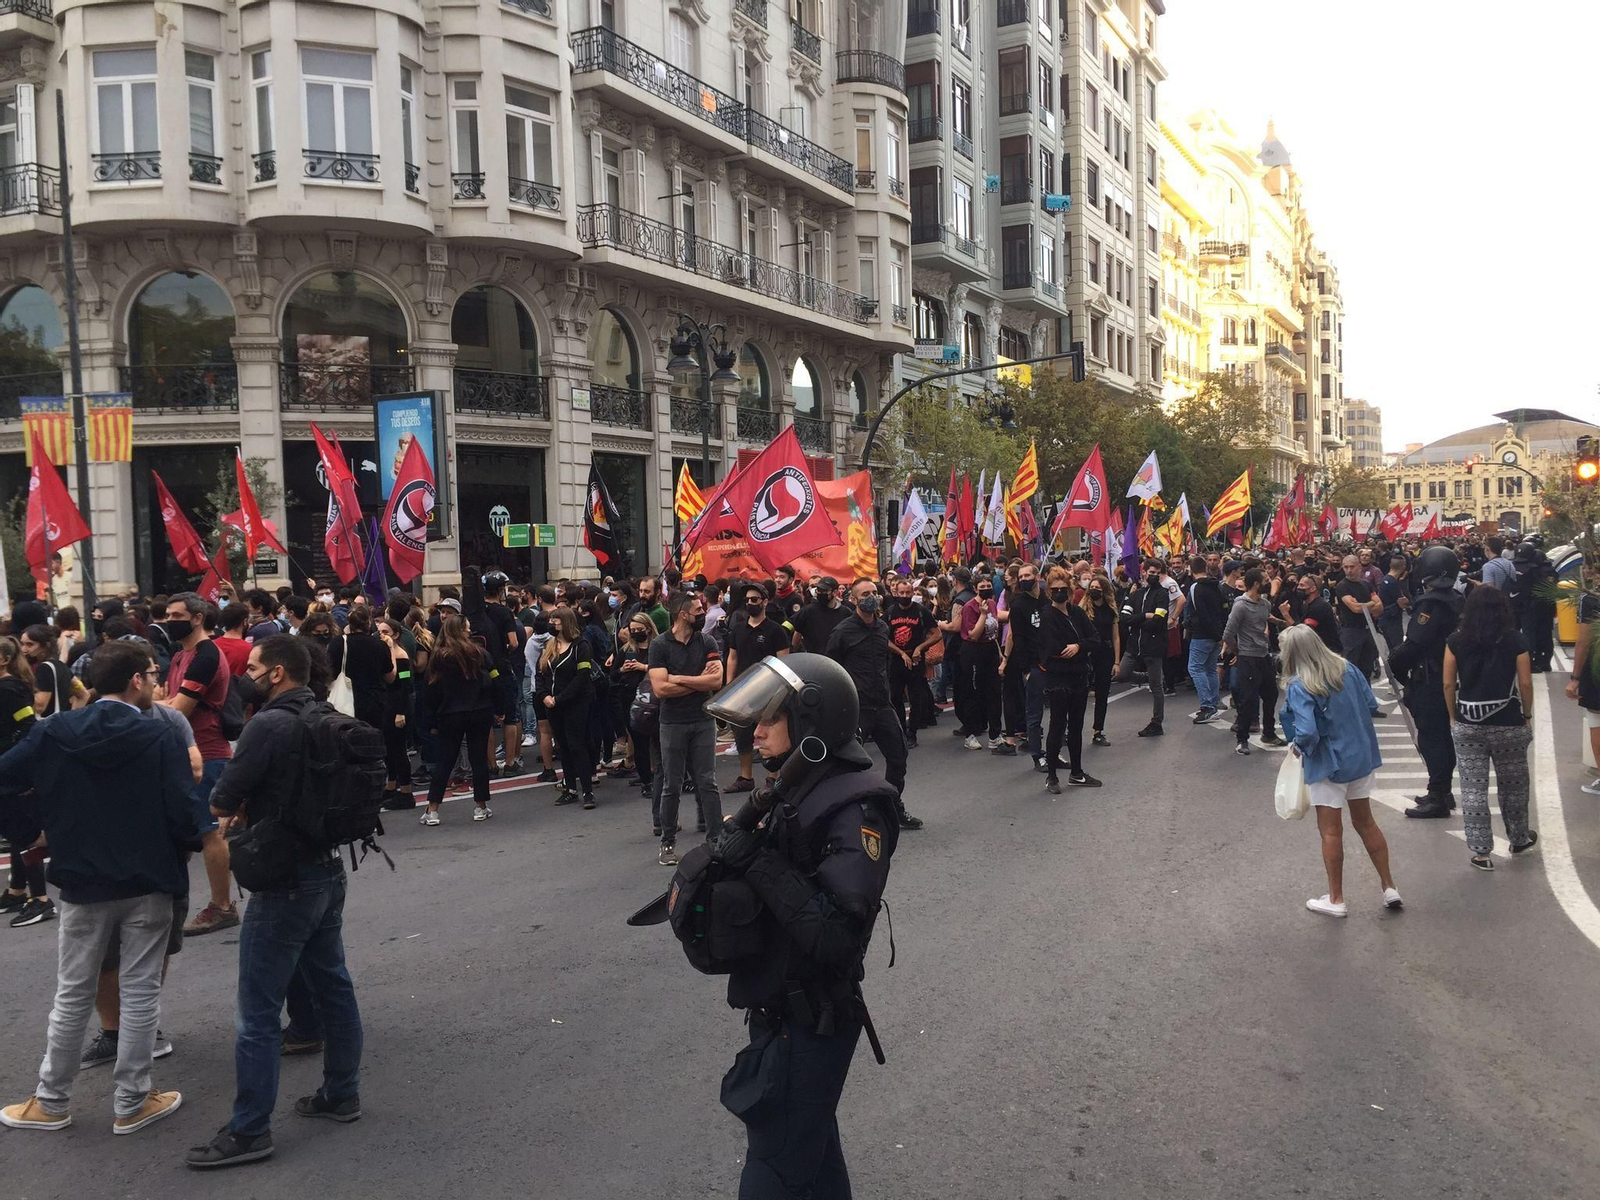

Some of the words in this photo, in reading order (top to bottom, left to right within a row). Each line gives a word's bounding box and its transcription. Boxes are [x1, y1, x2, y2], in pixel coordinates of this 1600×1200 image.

[392, 408, 419, 418] CUMPLIENDO
[390, 417, 401, 428] TUS
[401, 416, 421, 427] DESEOS
[784, 468, 813, 514] ANTIFEIXISTES
[394, 528, 426, 550] VALENC
